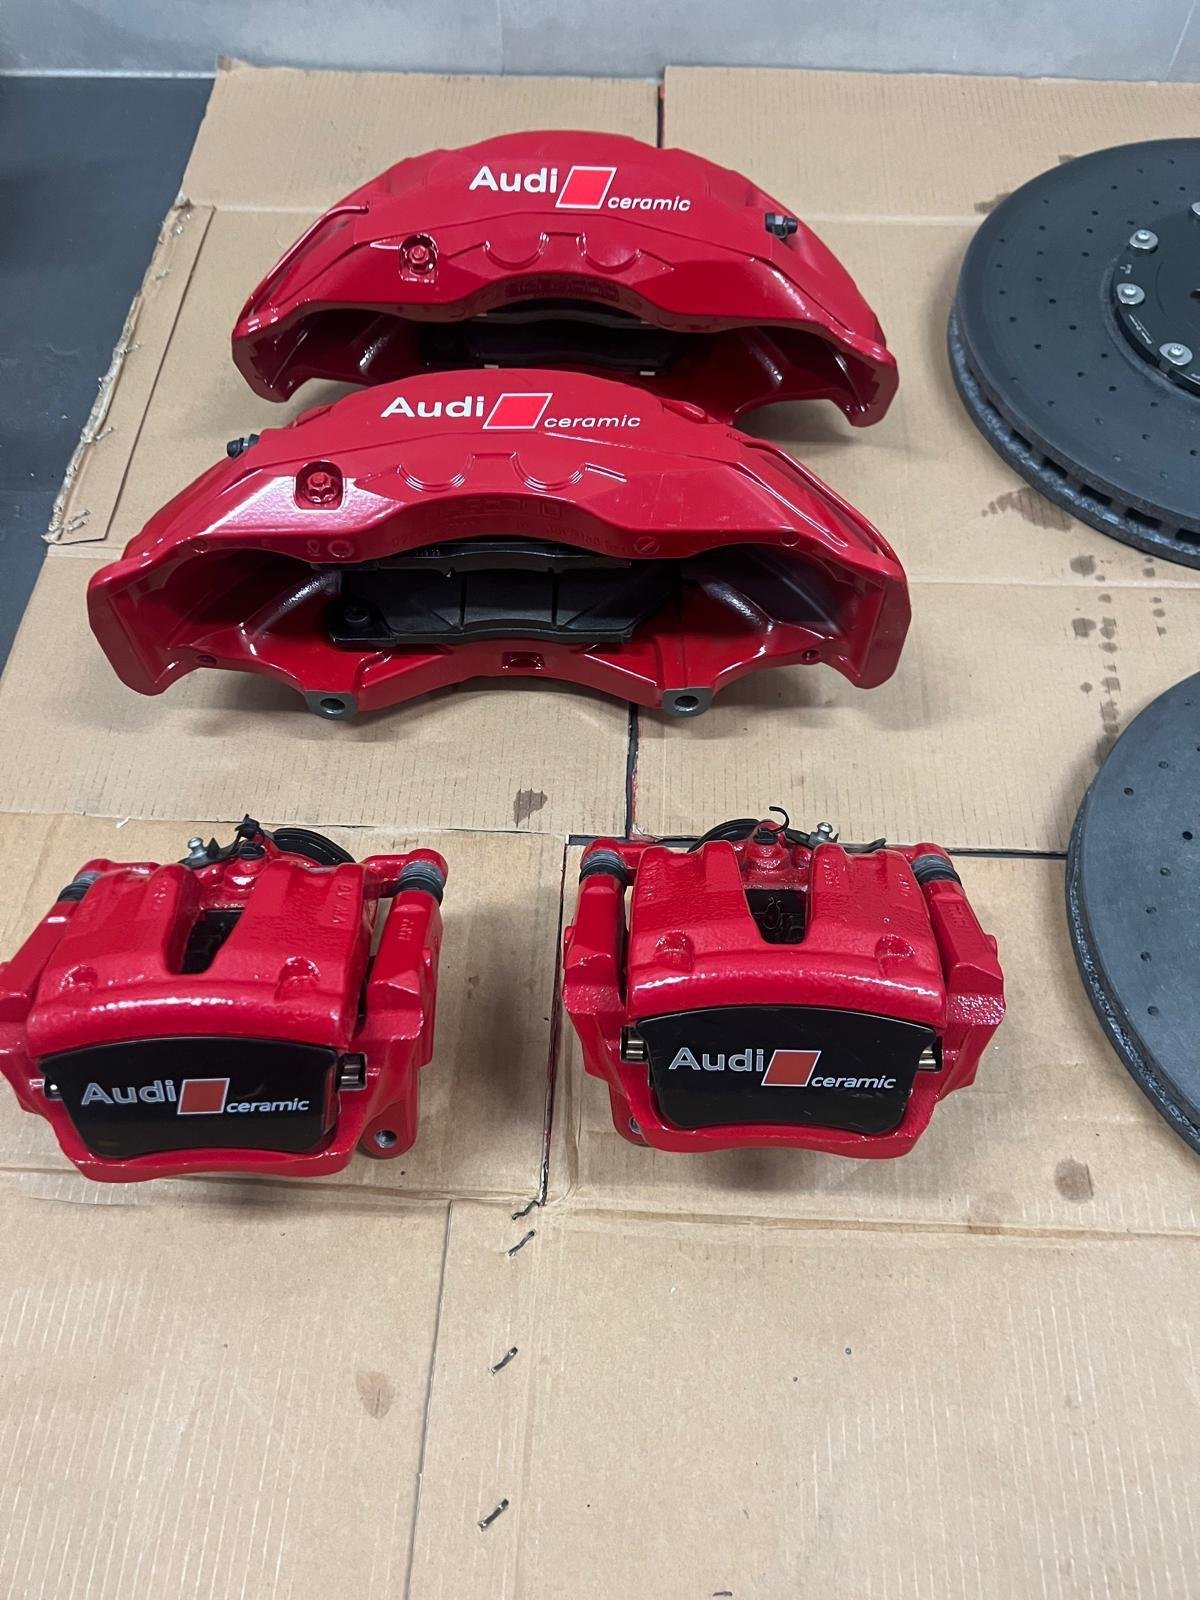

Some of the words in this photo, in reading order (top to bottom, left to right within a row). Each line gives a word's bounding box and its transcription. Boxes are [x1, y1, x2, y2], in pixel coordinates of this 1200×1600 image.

[469, 166, 558, 194] Audi
[607, 195, 691, 212] ceramic
[380, 396, 485, 418] Audi
[544, 414, 641, 429] ceramic
[668, 1047, 765, 1072] Audi
[811, 1075, 897, 1090] ceramic
[81, 1080, 177, 1106] Audi
[226, 1098, 310, 1113] ceramic
